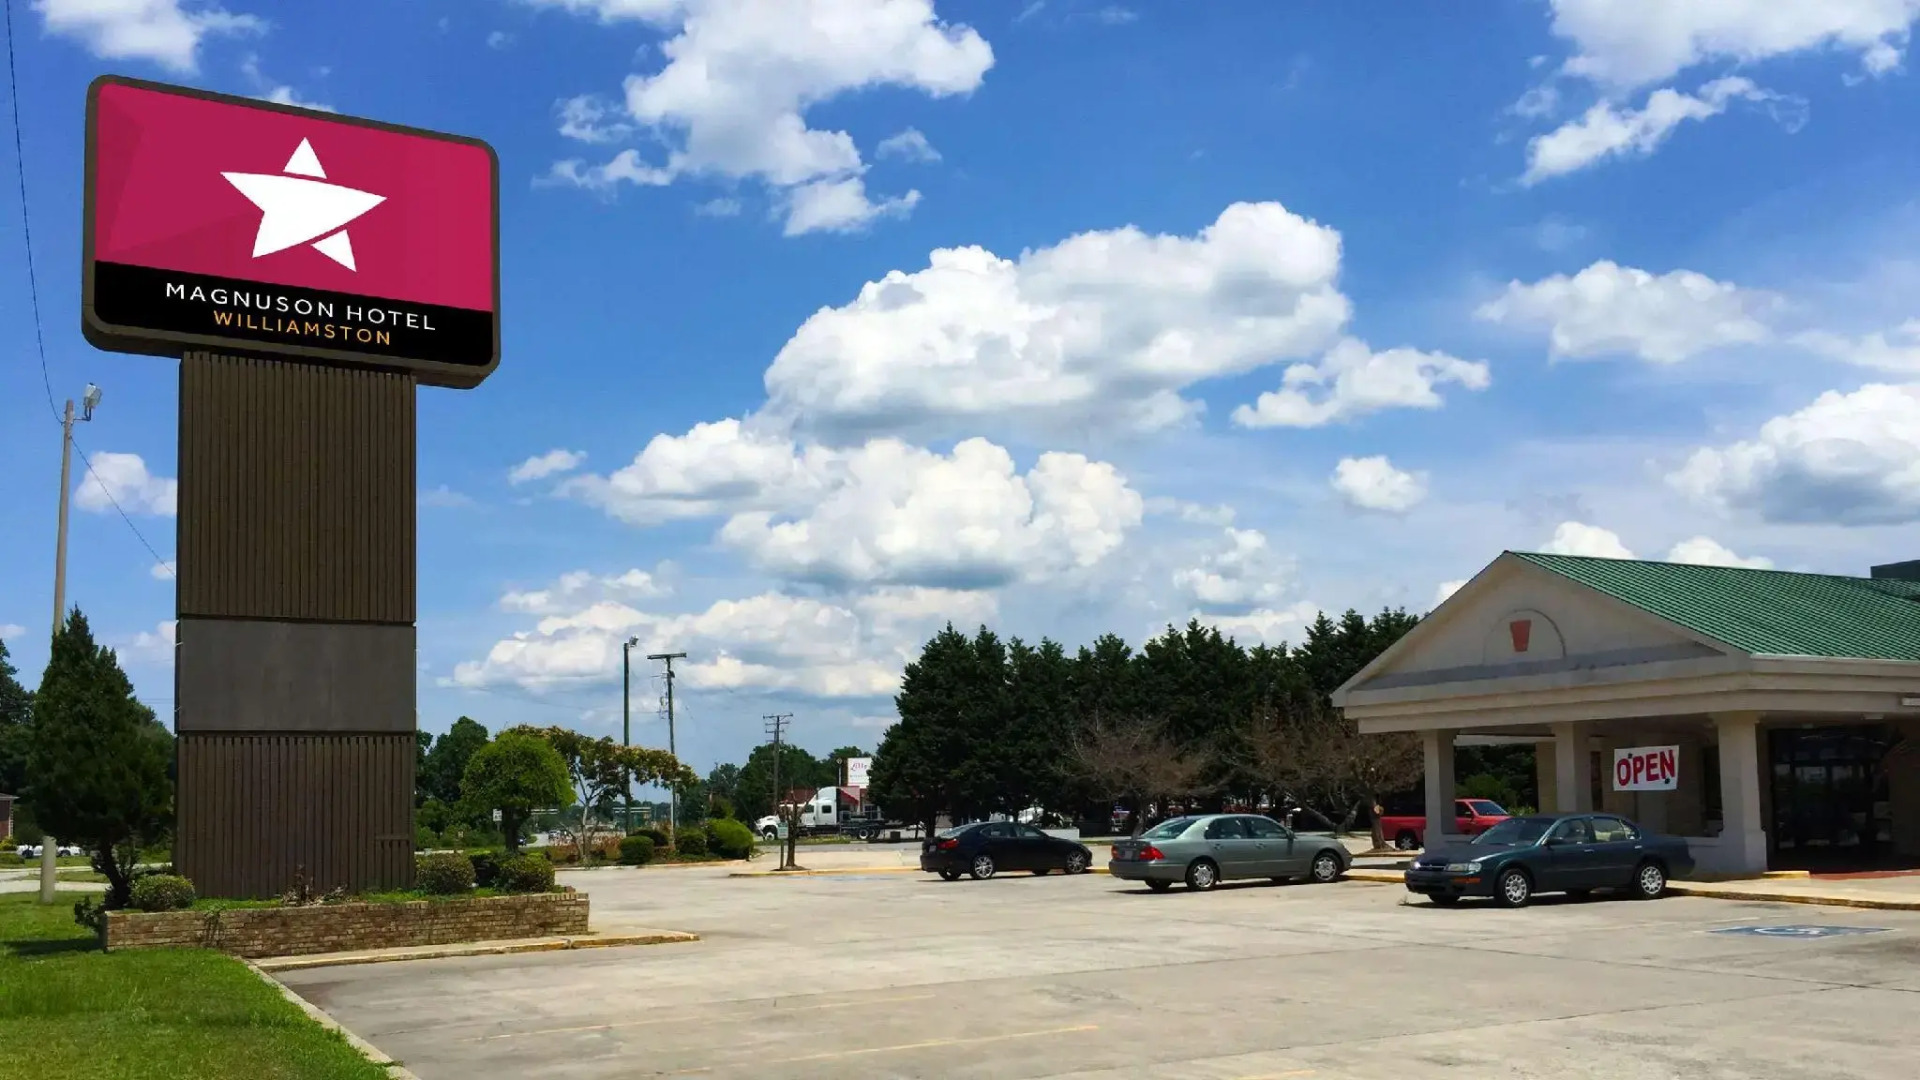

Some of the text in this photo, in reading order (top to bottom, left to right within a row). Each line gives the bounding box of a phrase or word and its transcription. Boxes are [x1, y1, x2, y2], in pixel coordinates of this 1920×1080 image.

[166, 282, 436, 331] MAGNUSON HOTEL
[214, 310, 391, 345] WILLIAMSTON
[1616, 749, 1675, 786] OPEN
